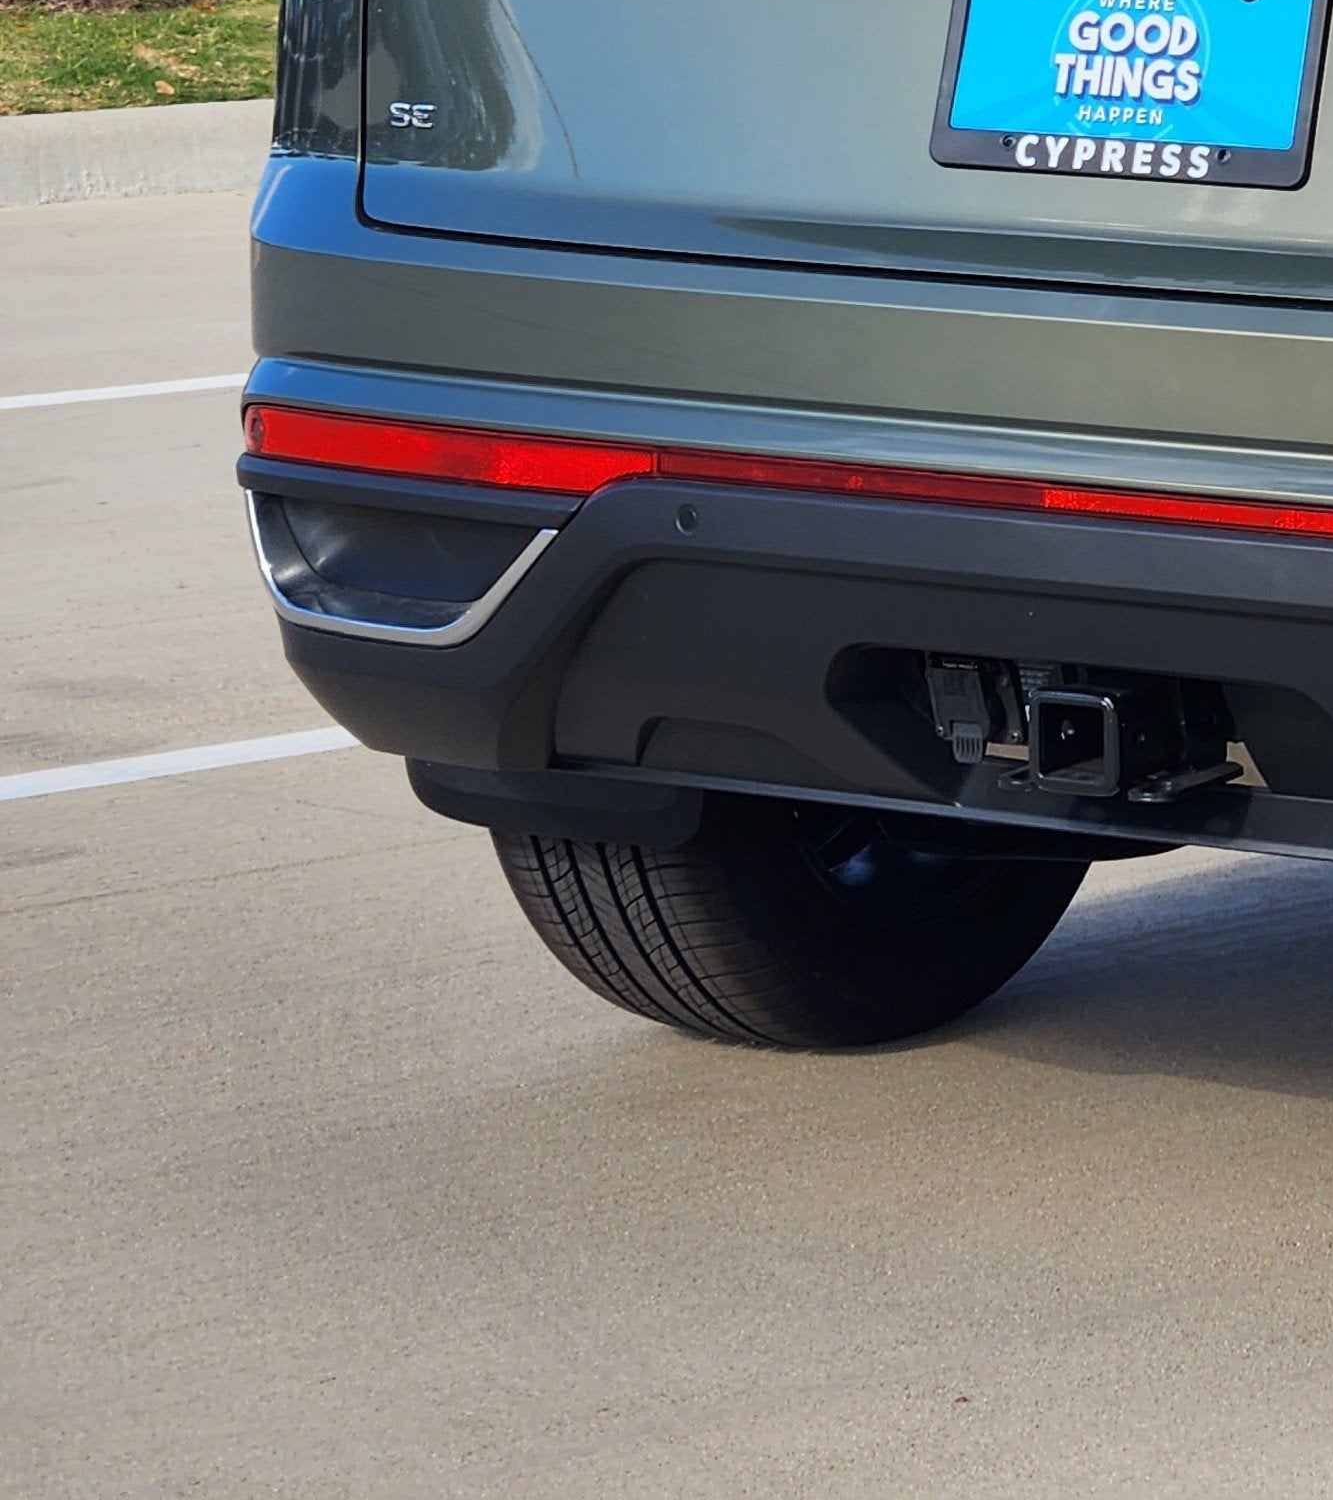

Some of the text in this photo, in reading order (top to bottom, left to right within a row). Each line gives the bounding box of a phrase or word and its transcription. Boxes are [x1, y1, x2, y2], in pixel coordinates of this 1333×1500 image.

[1068, 10, 1199, 56] GOOD
[1054, 54, 1201, 103] THINGS
[389, 102, 434, 128] SE
[1076, 105, 1165, 126] HAPPEN
[1014, 135, 1211, 180] CYPRESS
